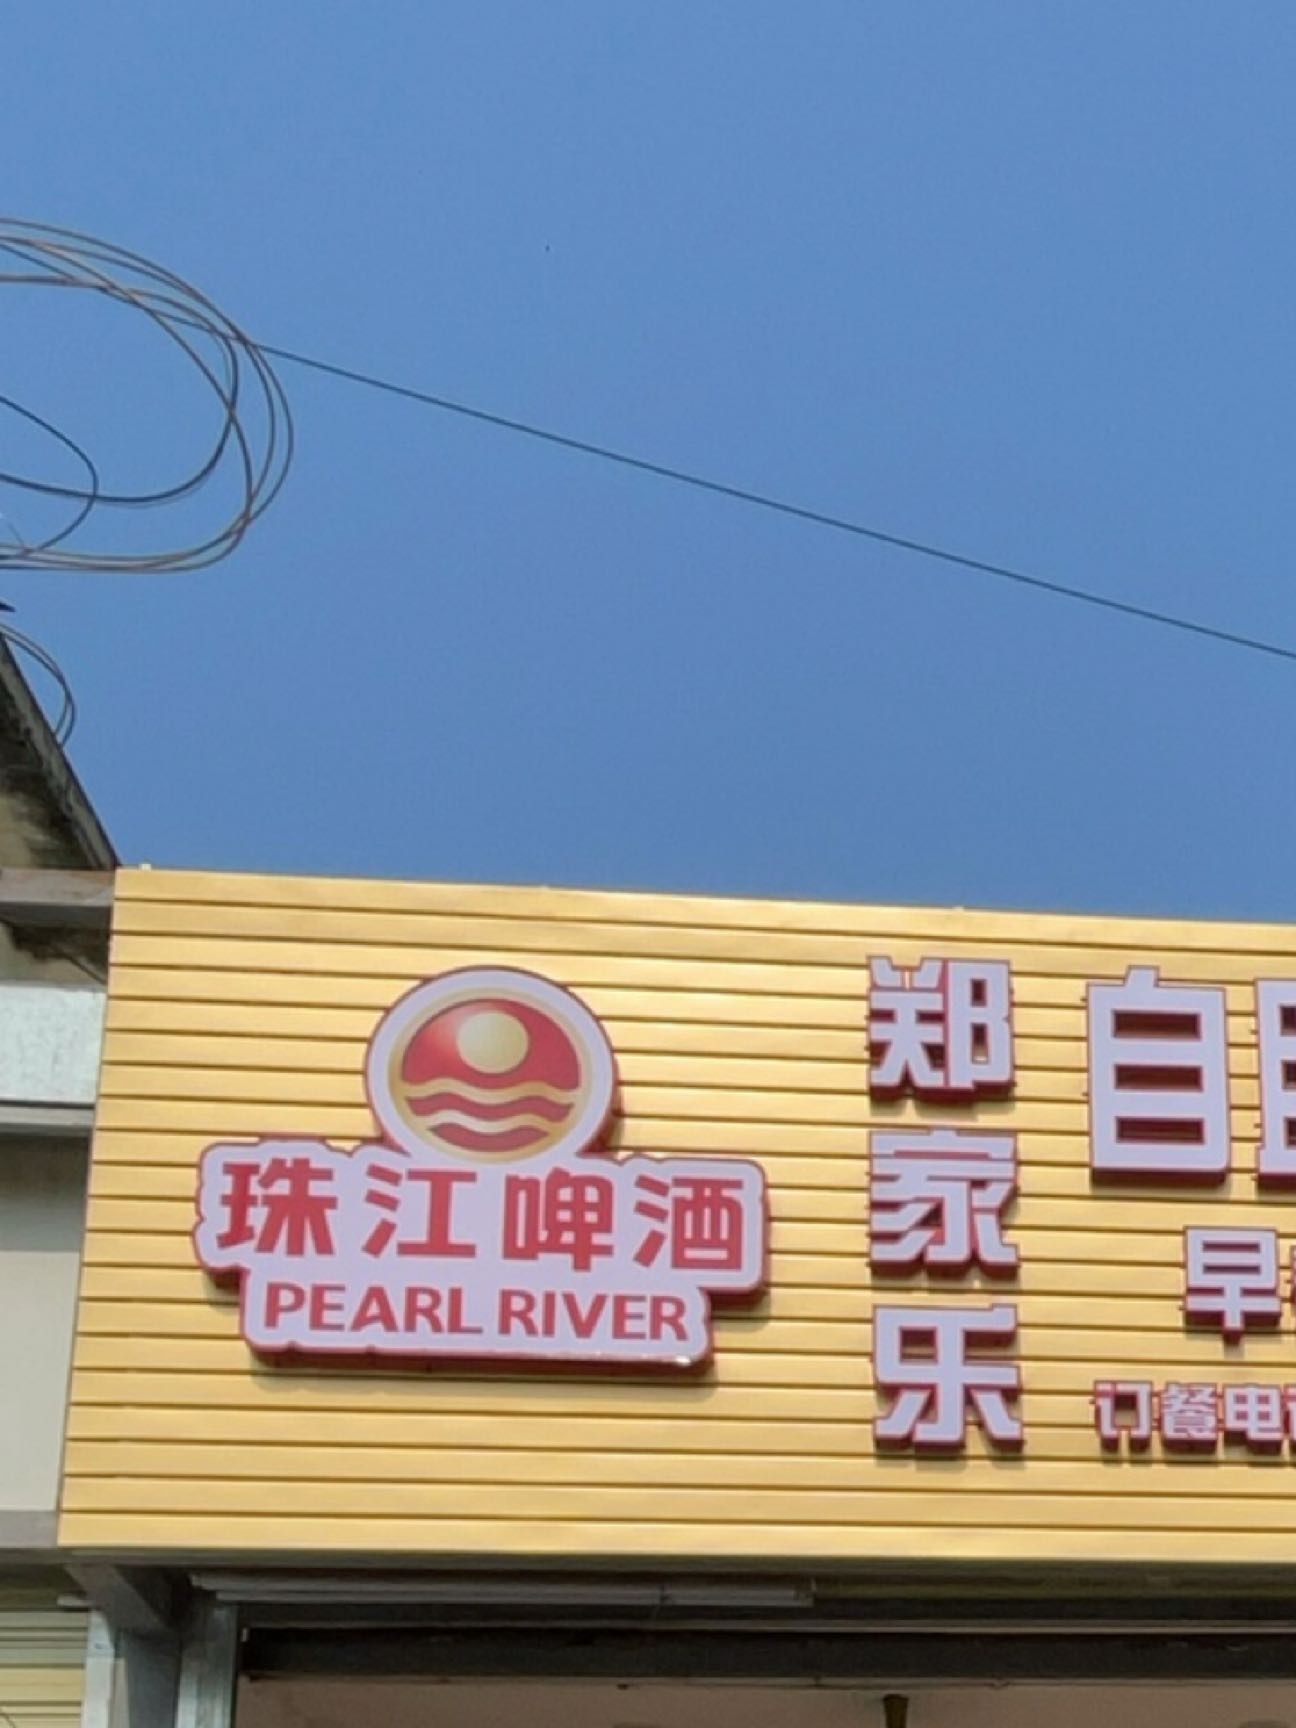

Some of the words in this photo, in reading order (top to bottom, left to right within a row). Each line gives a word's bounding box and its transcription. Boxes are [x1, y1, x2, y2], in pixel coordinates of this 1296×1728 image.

[216, 1156, 744, 1273] 珠江啤酒
[866, 955, 1024, 1448] 郑家乐
[263, 1282, 484, 1336] PEARL
[497, 1288, 690, 1342] RIVER
